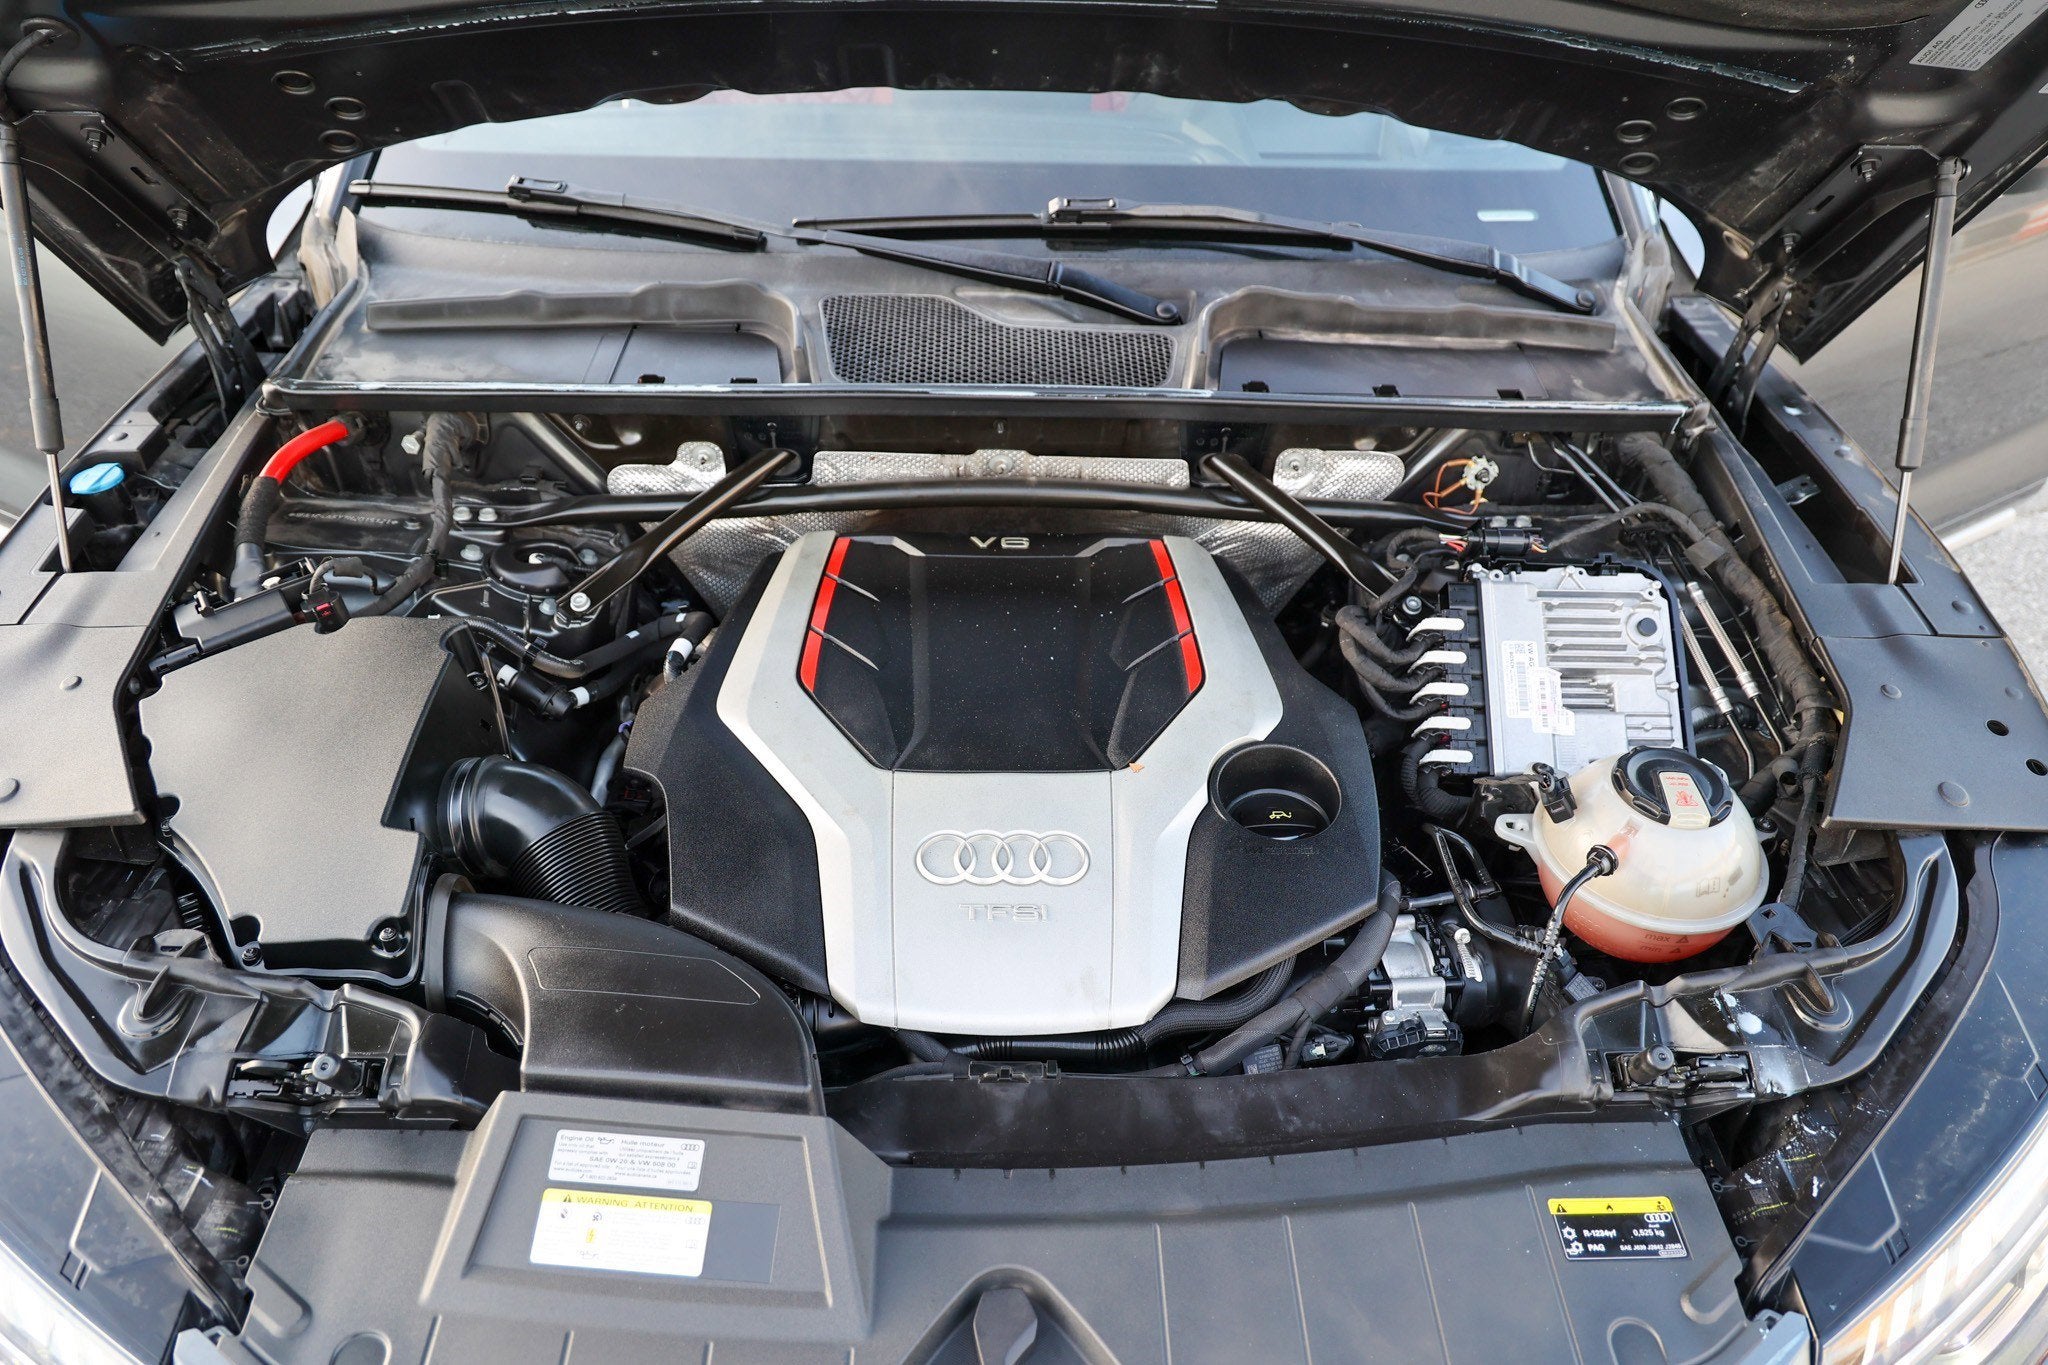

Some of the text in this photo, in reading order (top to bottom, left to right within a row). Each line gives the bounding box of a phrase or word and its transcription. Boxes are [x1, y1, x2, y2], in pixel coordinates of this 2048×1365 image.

[1918, 40, 1943, 62] AUDI AG
[969, 536, 1030, 550] V6
[1527, 642, 1535, 667] VW AG
[958, 903, 1049, 922] TFSI
[1645, 934, 1670, 943] max
[560, 1134, 583, 1142] Engine
[577, 1196, 693, 1213] WARNING ATTENTION
[1583, 1229, 1665, 1238] R-1234yf 0,525 kg
[1587, 1243, 1606, 1252] PAG
